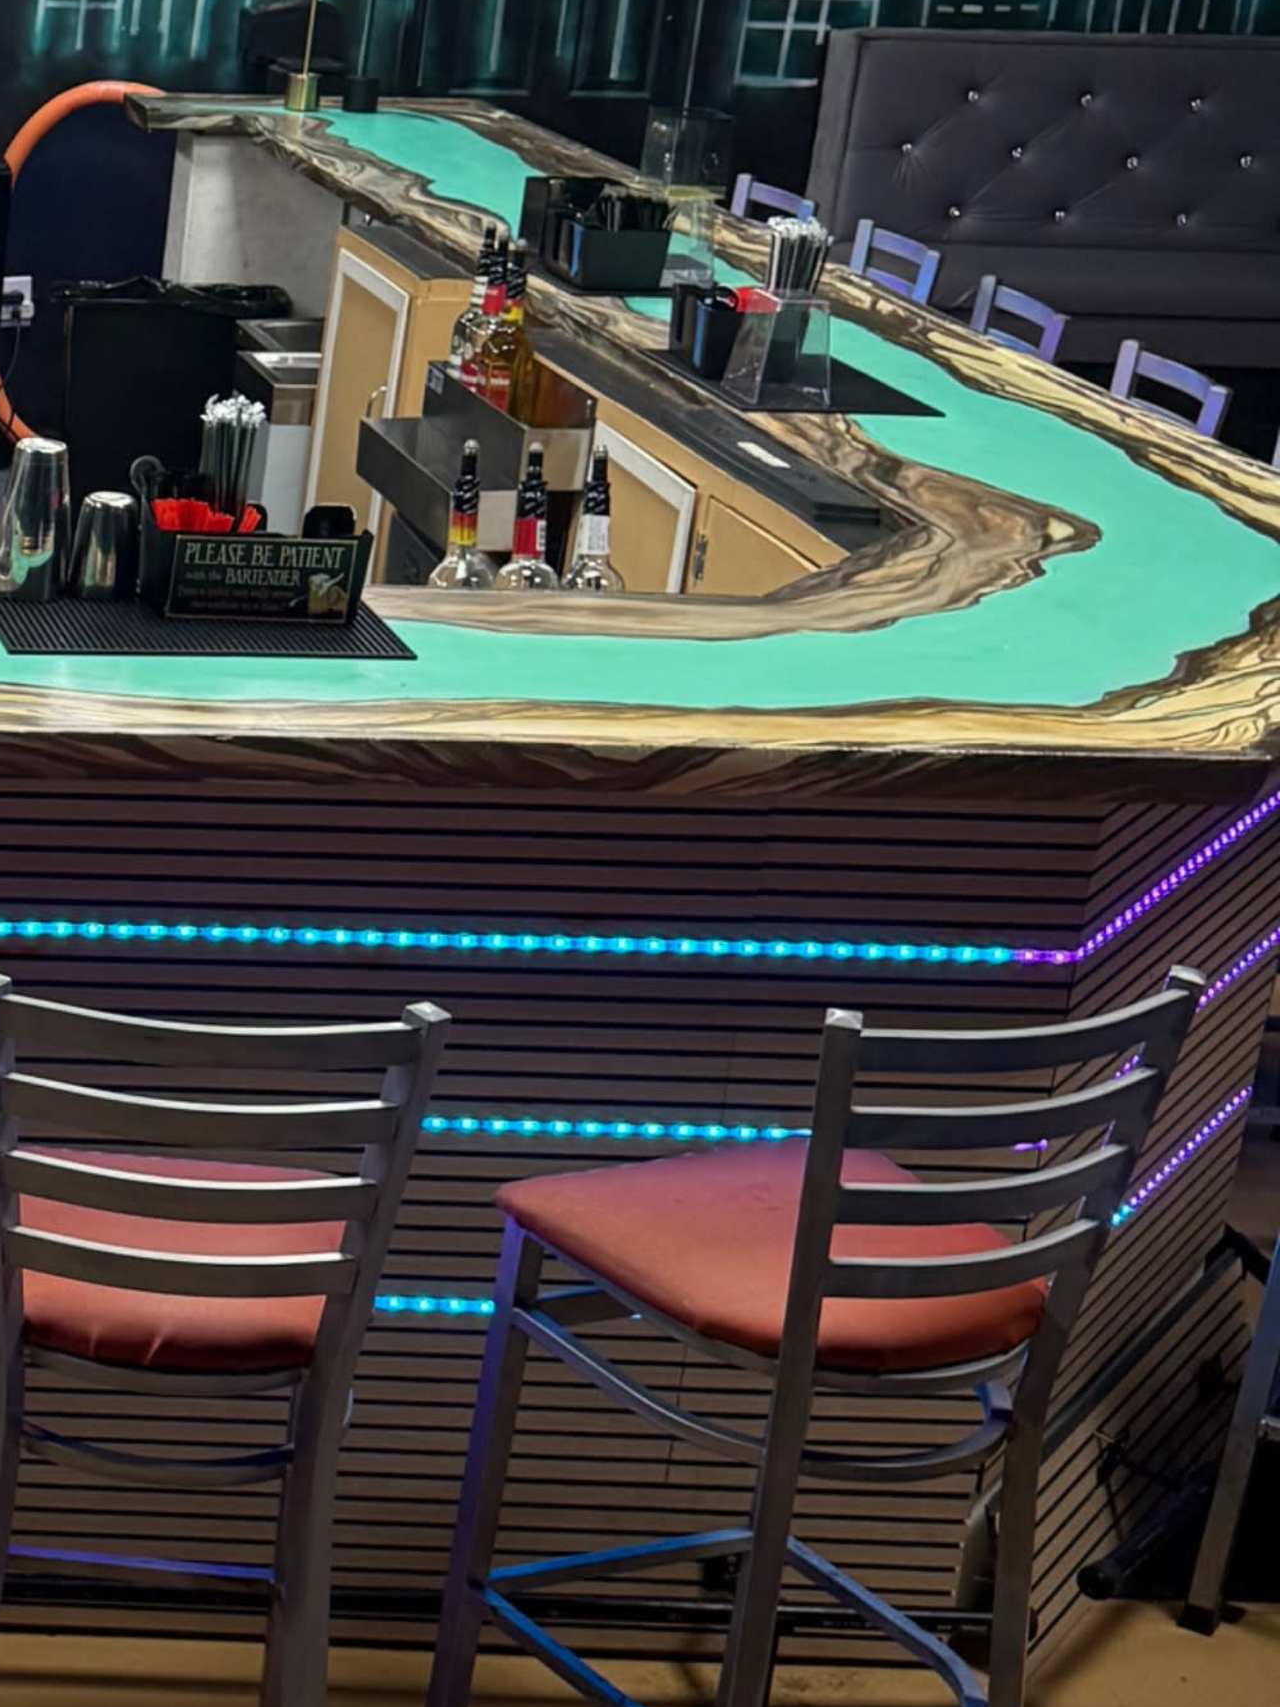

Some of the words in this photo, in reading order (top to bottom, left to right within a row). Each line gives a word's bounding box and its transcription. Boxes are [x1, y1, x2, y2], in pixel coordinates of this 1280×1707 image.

[184, 543, 247, 566] PLEASE
[251, 545, 275, 567] BE
[279, 546, 346, 569] PATIENT
[208, 571, 223, 582] the
[225, 568, 301, 587] BARTENDER
